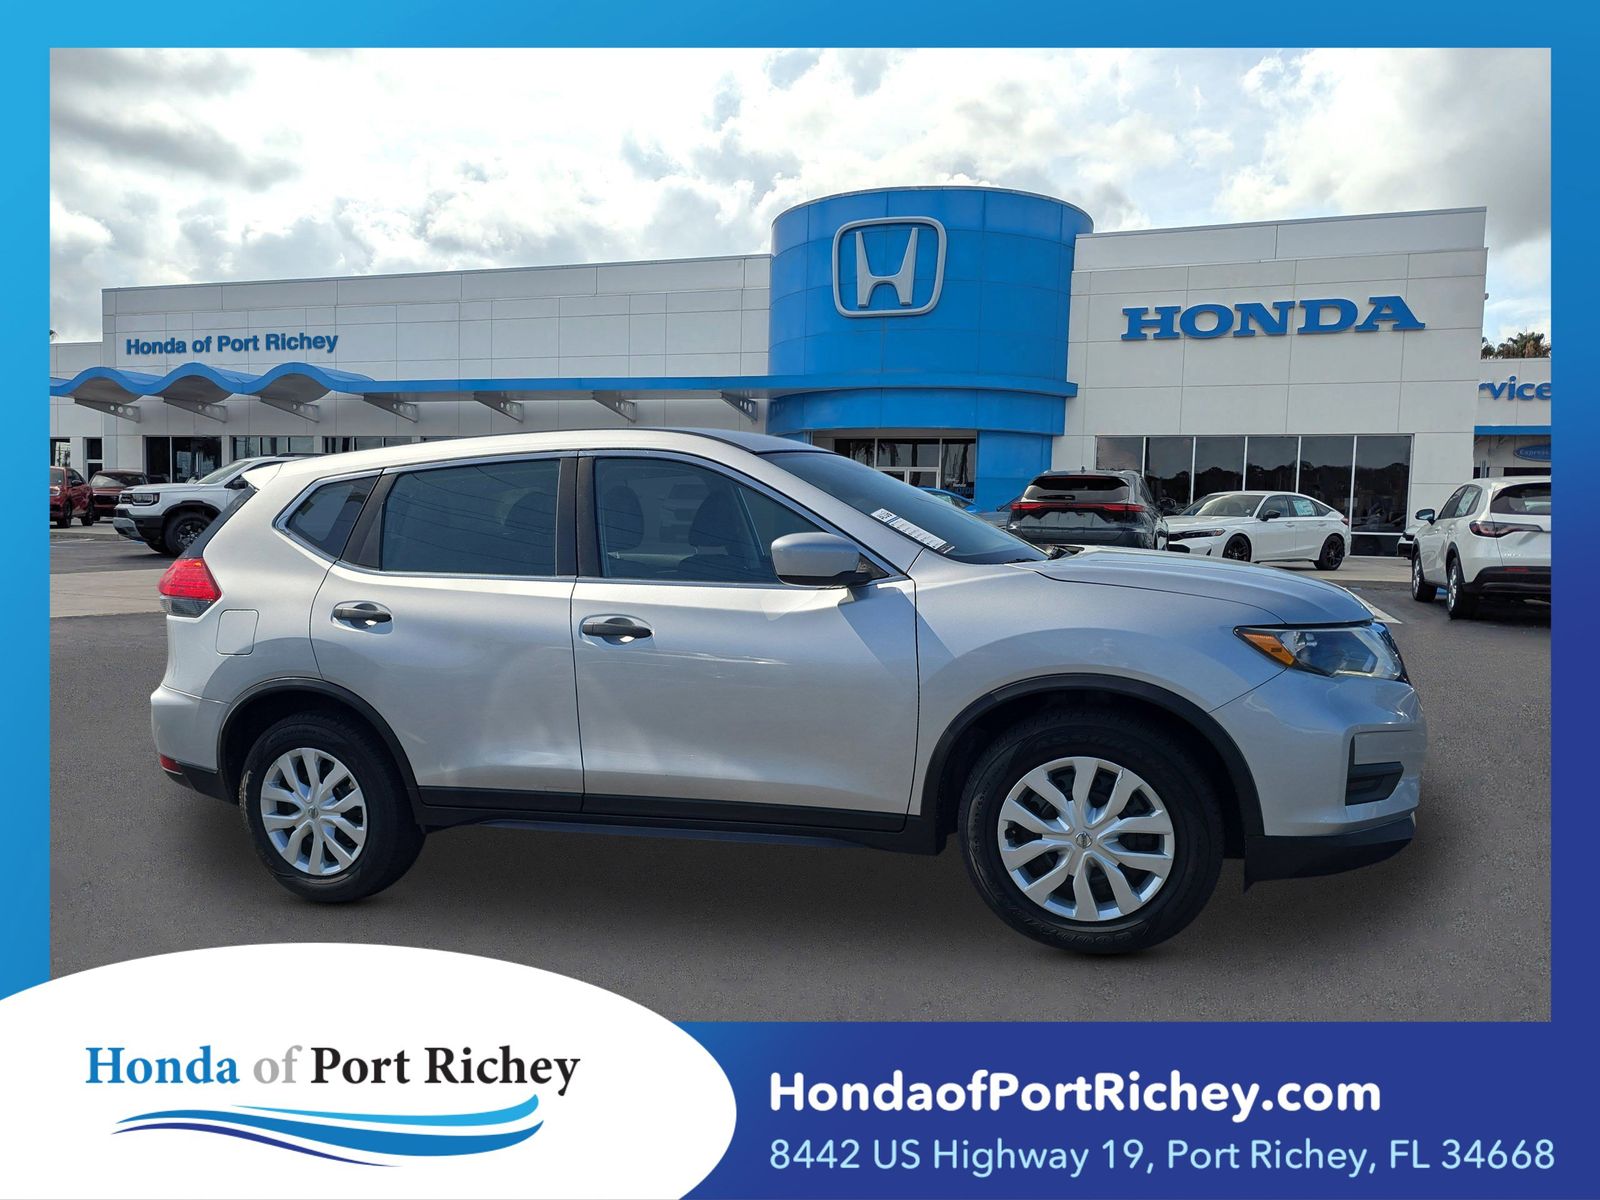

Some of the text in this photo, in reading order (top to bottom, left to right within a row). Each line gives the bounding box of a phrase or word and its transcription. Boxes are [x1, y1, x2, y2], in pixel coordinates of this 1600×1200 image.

[1120, 295, 1426, 341] HONDA
[126, 332, 338, 355] Honda of Port Richey
